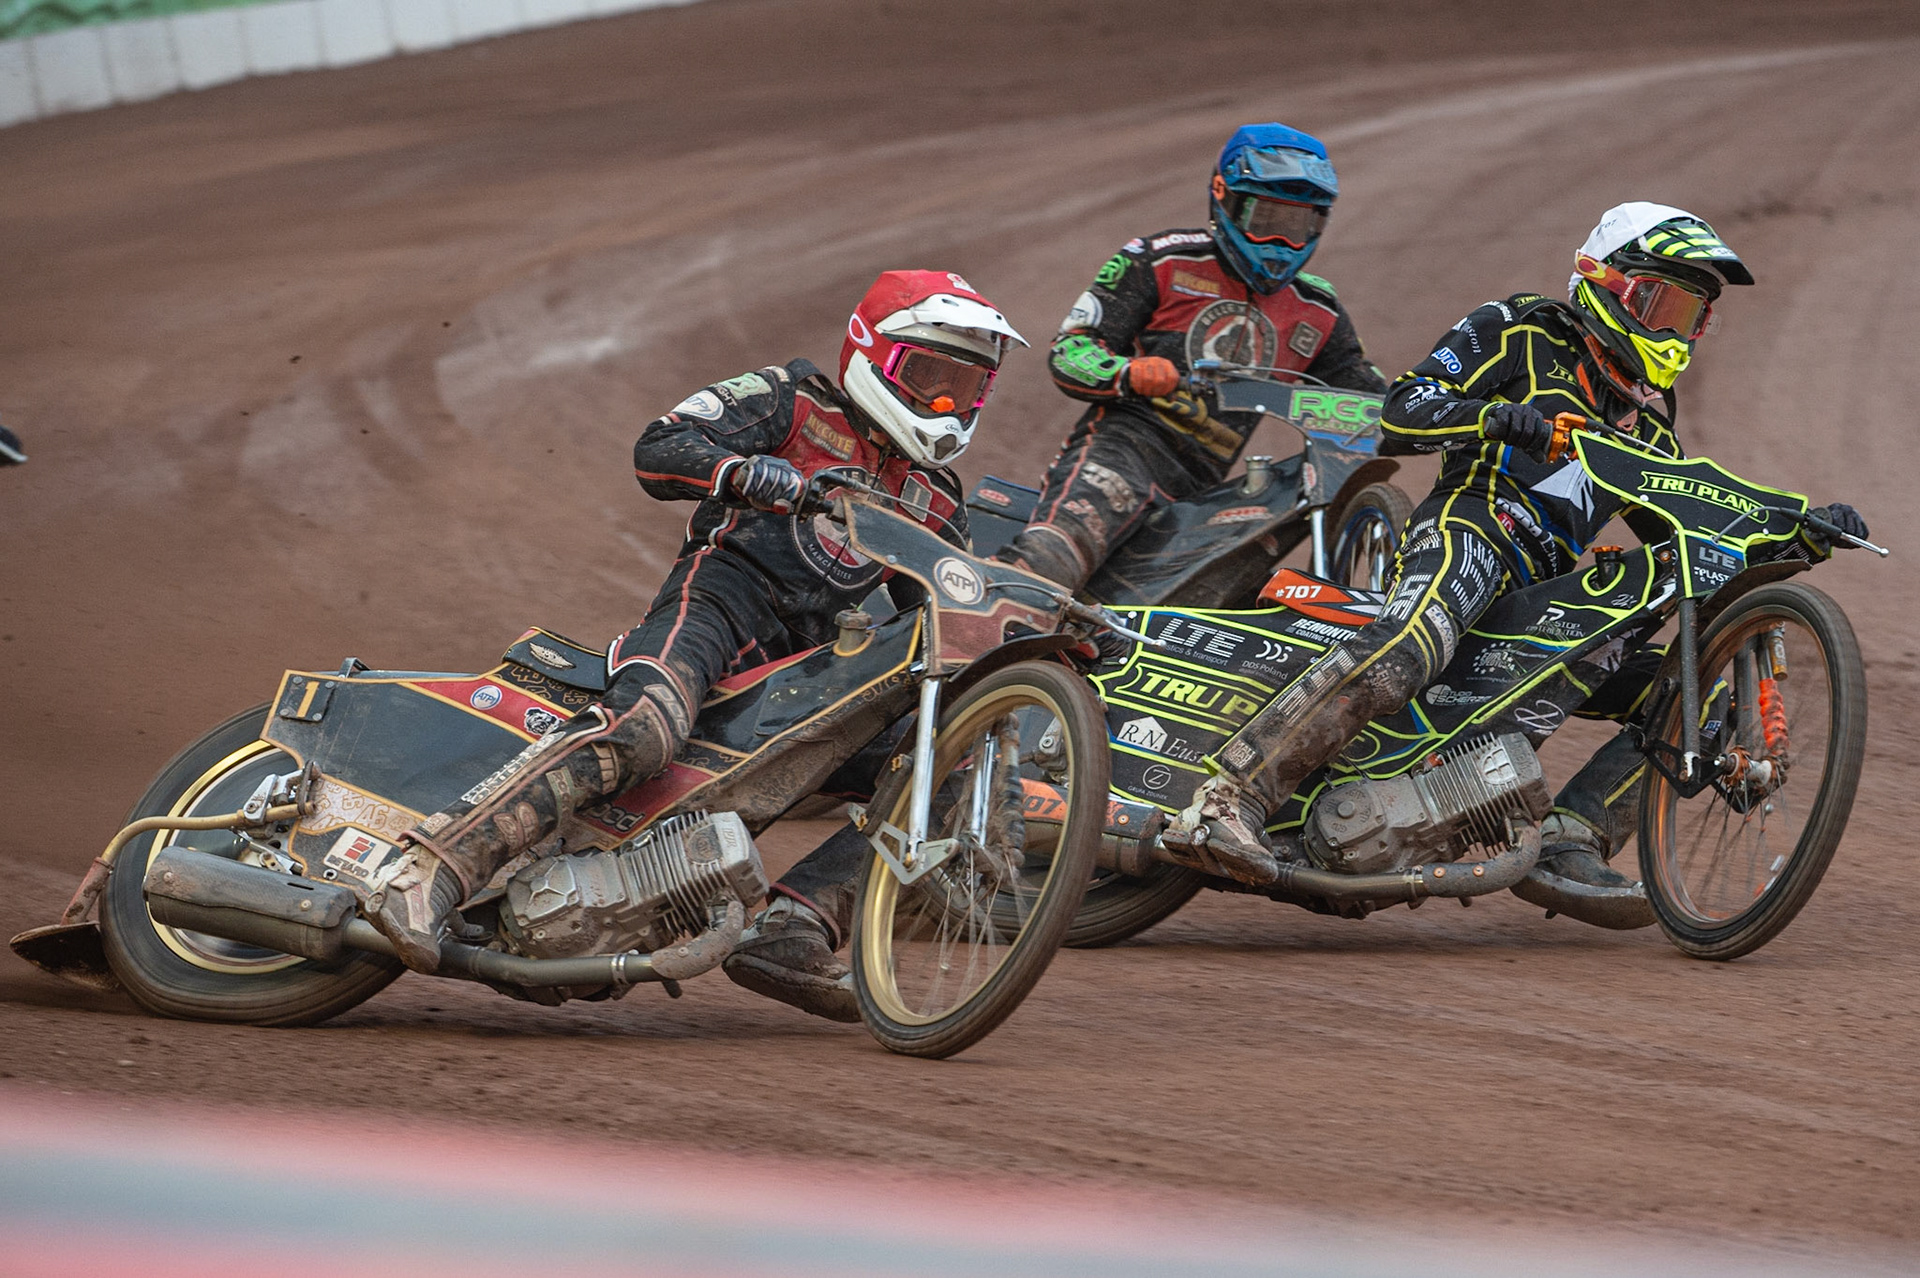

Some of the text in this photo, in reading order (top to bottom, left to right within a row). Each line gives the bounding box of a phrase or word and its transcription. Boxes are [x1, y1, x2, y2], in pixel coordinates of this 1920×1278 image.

[1152, 233, 1213, 251] MOTUL
[1649, 476, 1760, 517] TRU PLANT
[1698, 546, 1737, 570] LTE
[942, 569, 976, 595] ATPI
[1275, 585, 1322, 599] #707
[1157, 617, 1246, 659] LTE
[1295, 627, 1324, 644] COATING
[1192, 649, 1229, 667] transport
[1241, 660, 1260, 670] DDS
[1259, 663, 1289, 680] Poland
[296, 680, 320, 718] 1
[476, 691, 497, 705] ATPI
[1139, 671, 1224, 709] TRU
[1023, 795, 1062, 815] 07
